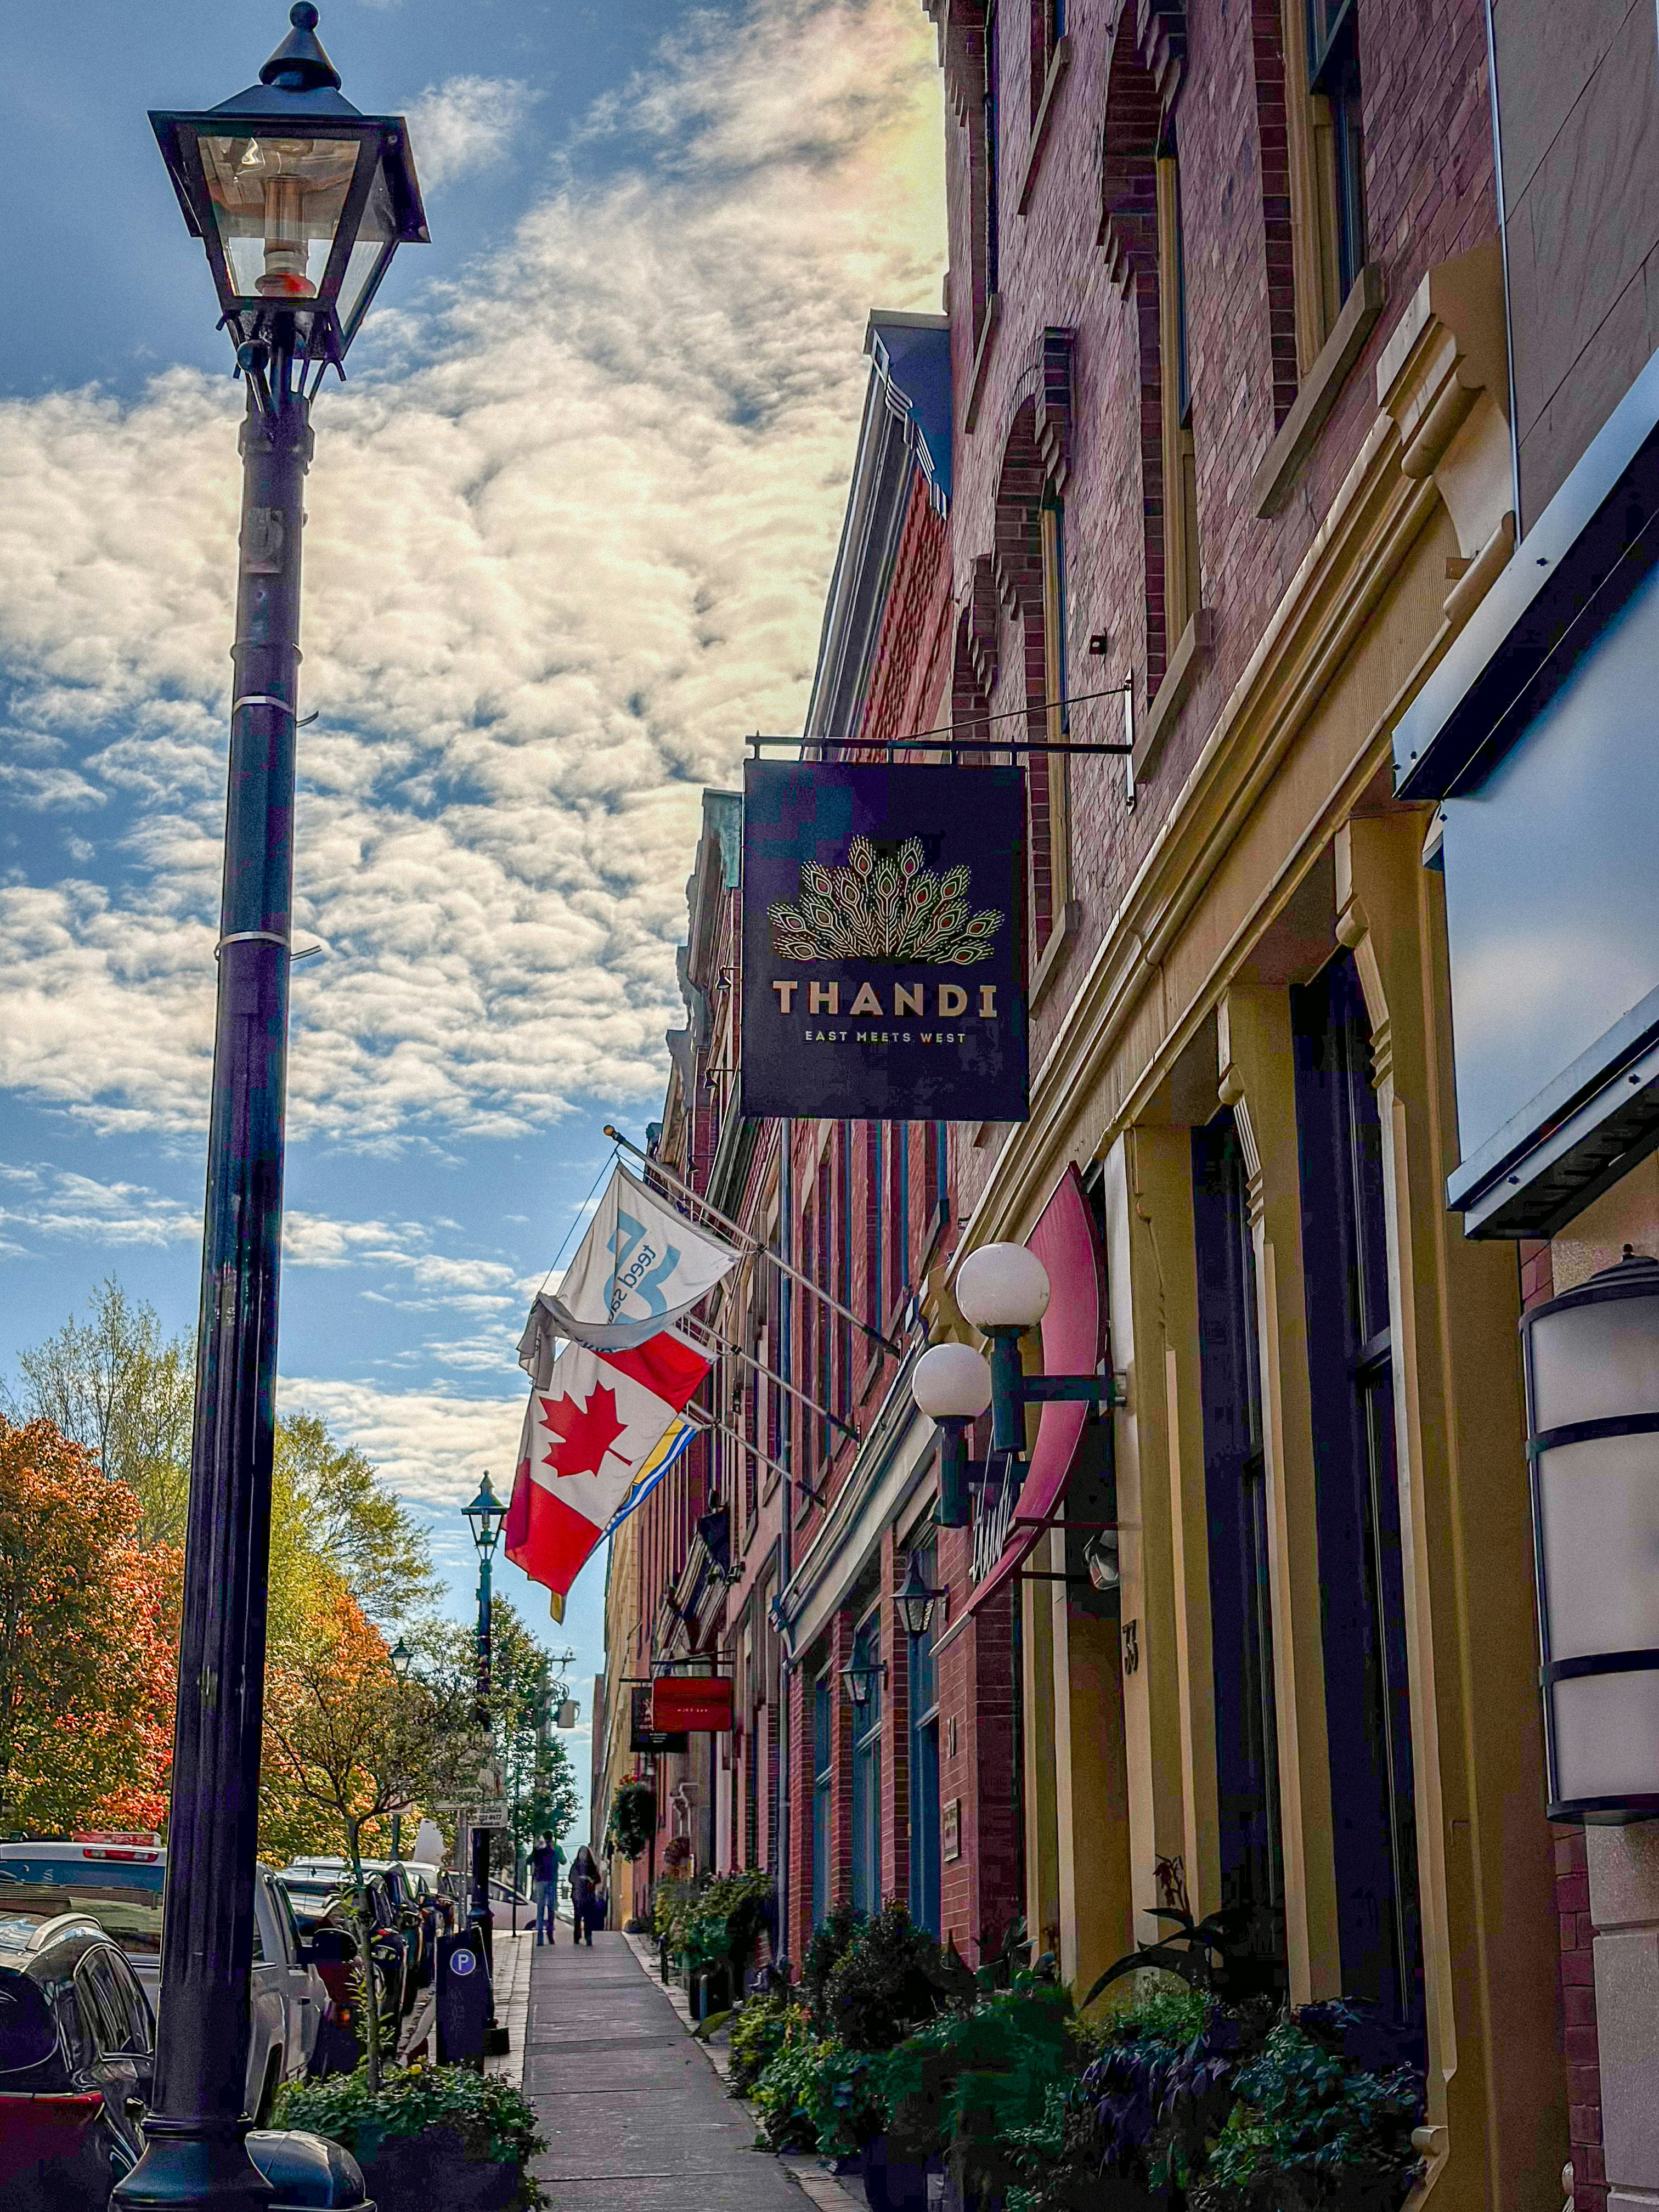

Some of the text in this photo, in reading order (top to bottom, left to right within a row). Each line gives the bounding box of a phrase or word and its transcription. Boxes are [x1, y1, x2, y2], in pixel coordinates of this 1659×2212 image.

[772, 980, 997, 1017] THANDI
[805, 1030, 966, 1043] EAST MEETS WEST
[458, 1954, 469, 1970] P
